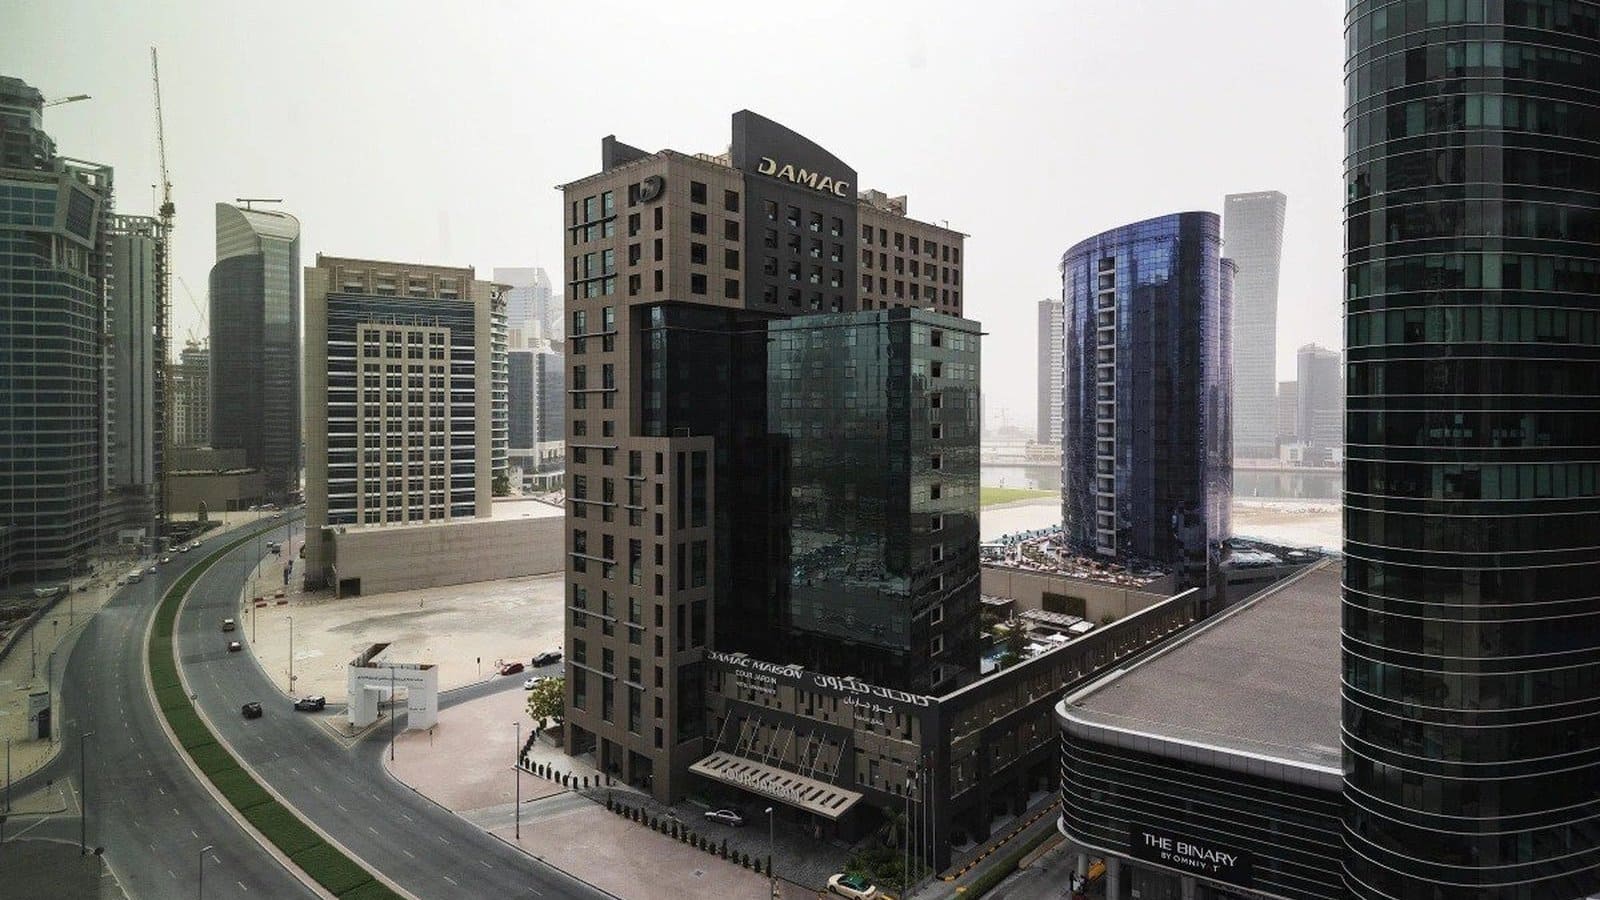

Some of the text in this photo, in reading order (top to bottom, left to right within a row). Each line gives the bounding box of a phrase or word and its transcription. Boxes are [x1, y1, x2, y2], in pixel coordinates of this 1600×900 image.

[757, 156, 850, 198] DAMAC
[707, 649, 803, 680] DAMAC MAISON
[1142, 832, 1238, 867] THE BINARY
[1160, 852, 1171, 860] BY
